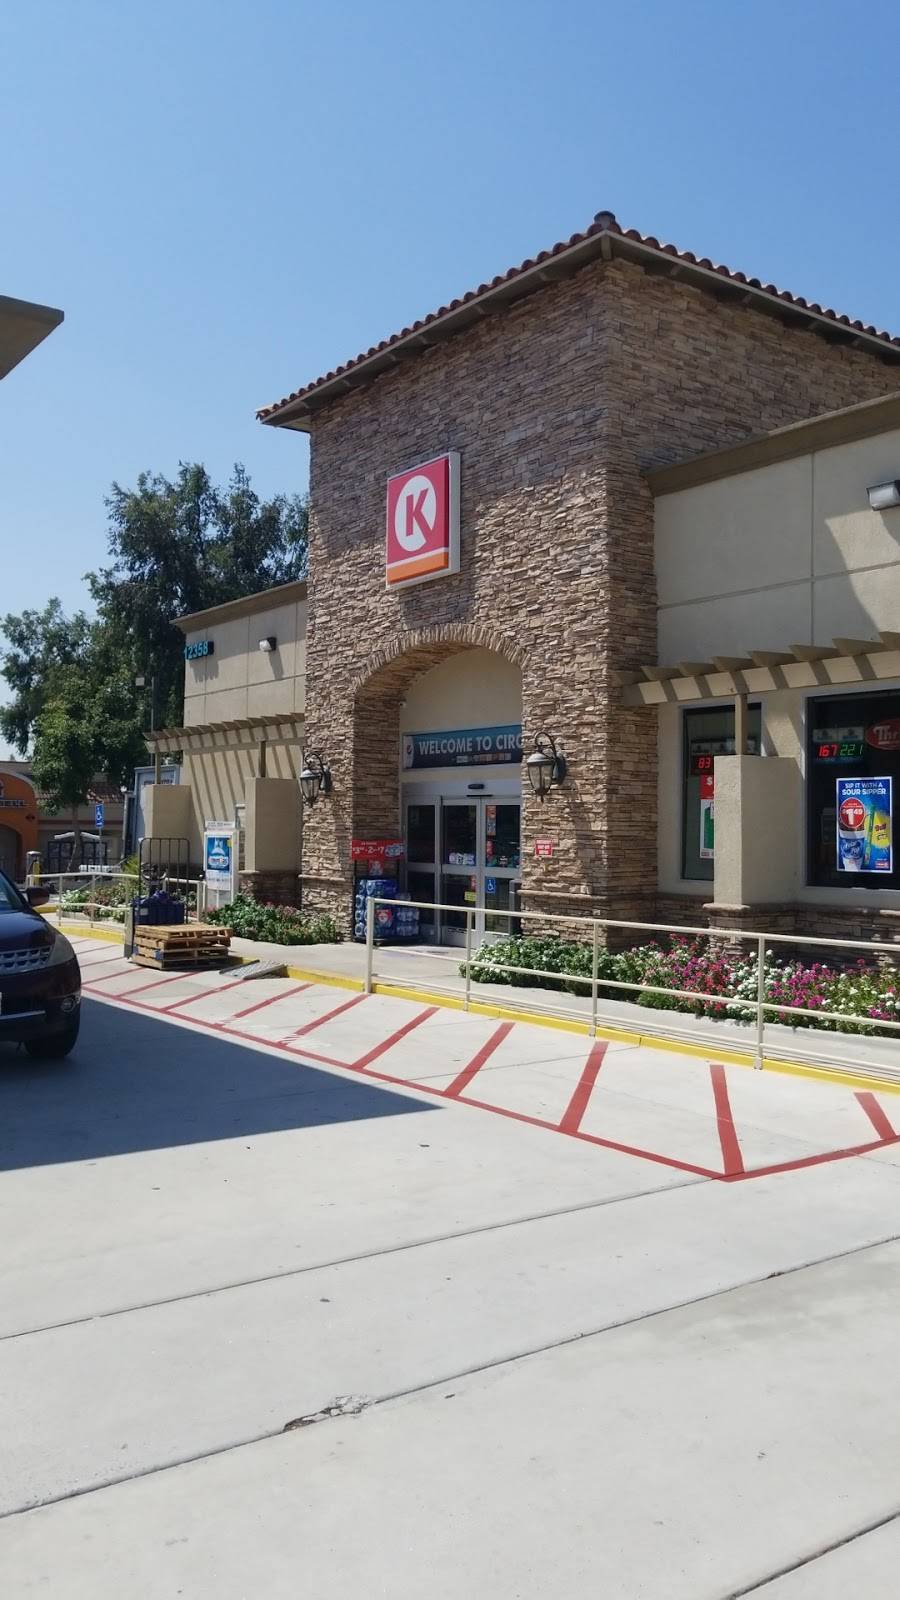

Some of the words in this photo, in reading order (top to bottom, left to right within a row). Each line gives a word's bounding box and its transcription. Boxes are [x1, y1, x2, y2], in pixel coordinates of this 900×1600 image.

[406, 488, 433, 542] K
[419, 738, 472, 755] WELCOME
[475, 736, 492, 751] TO
[841, 788, 861, 796] SOUR
[862, 787, 887, 795] SIPPER
